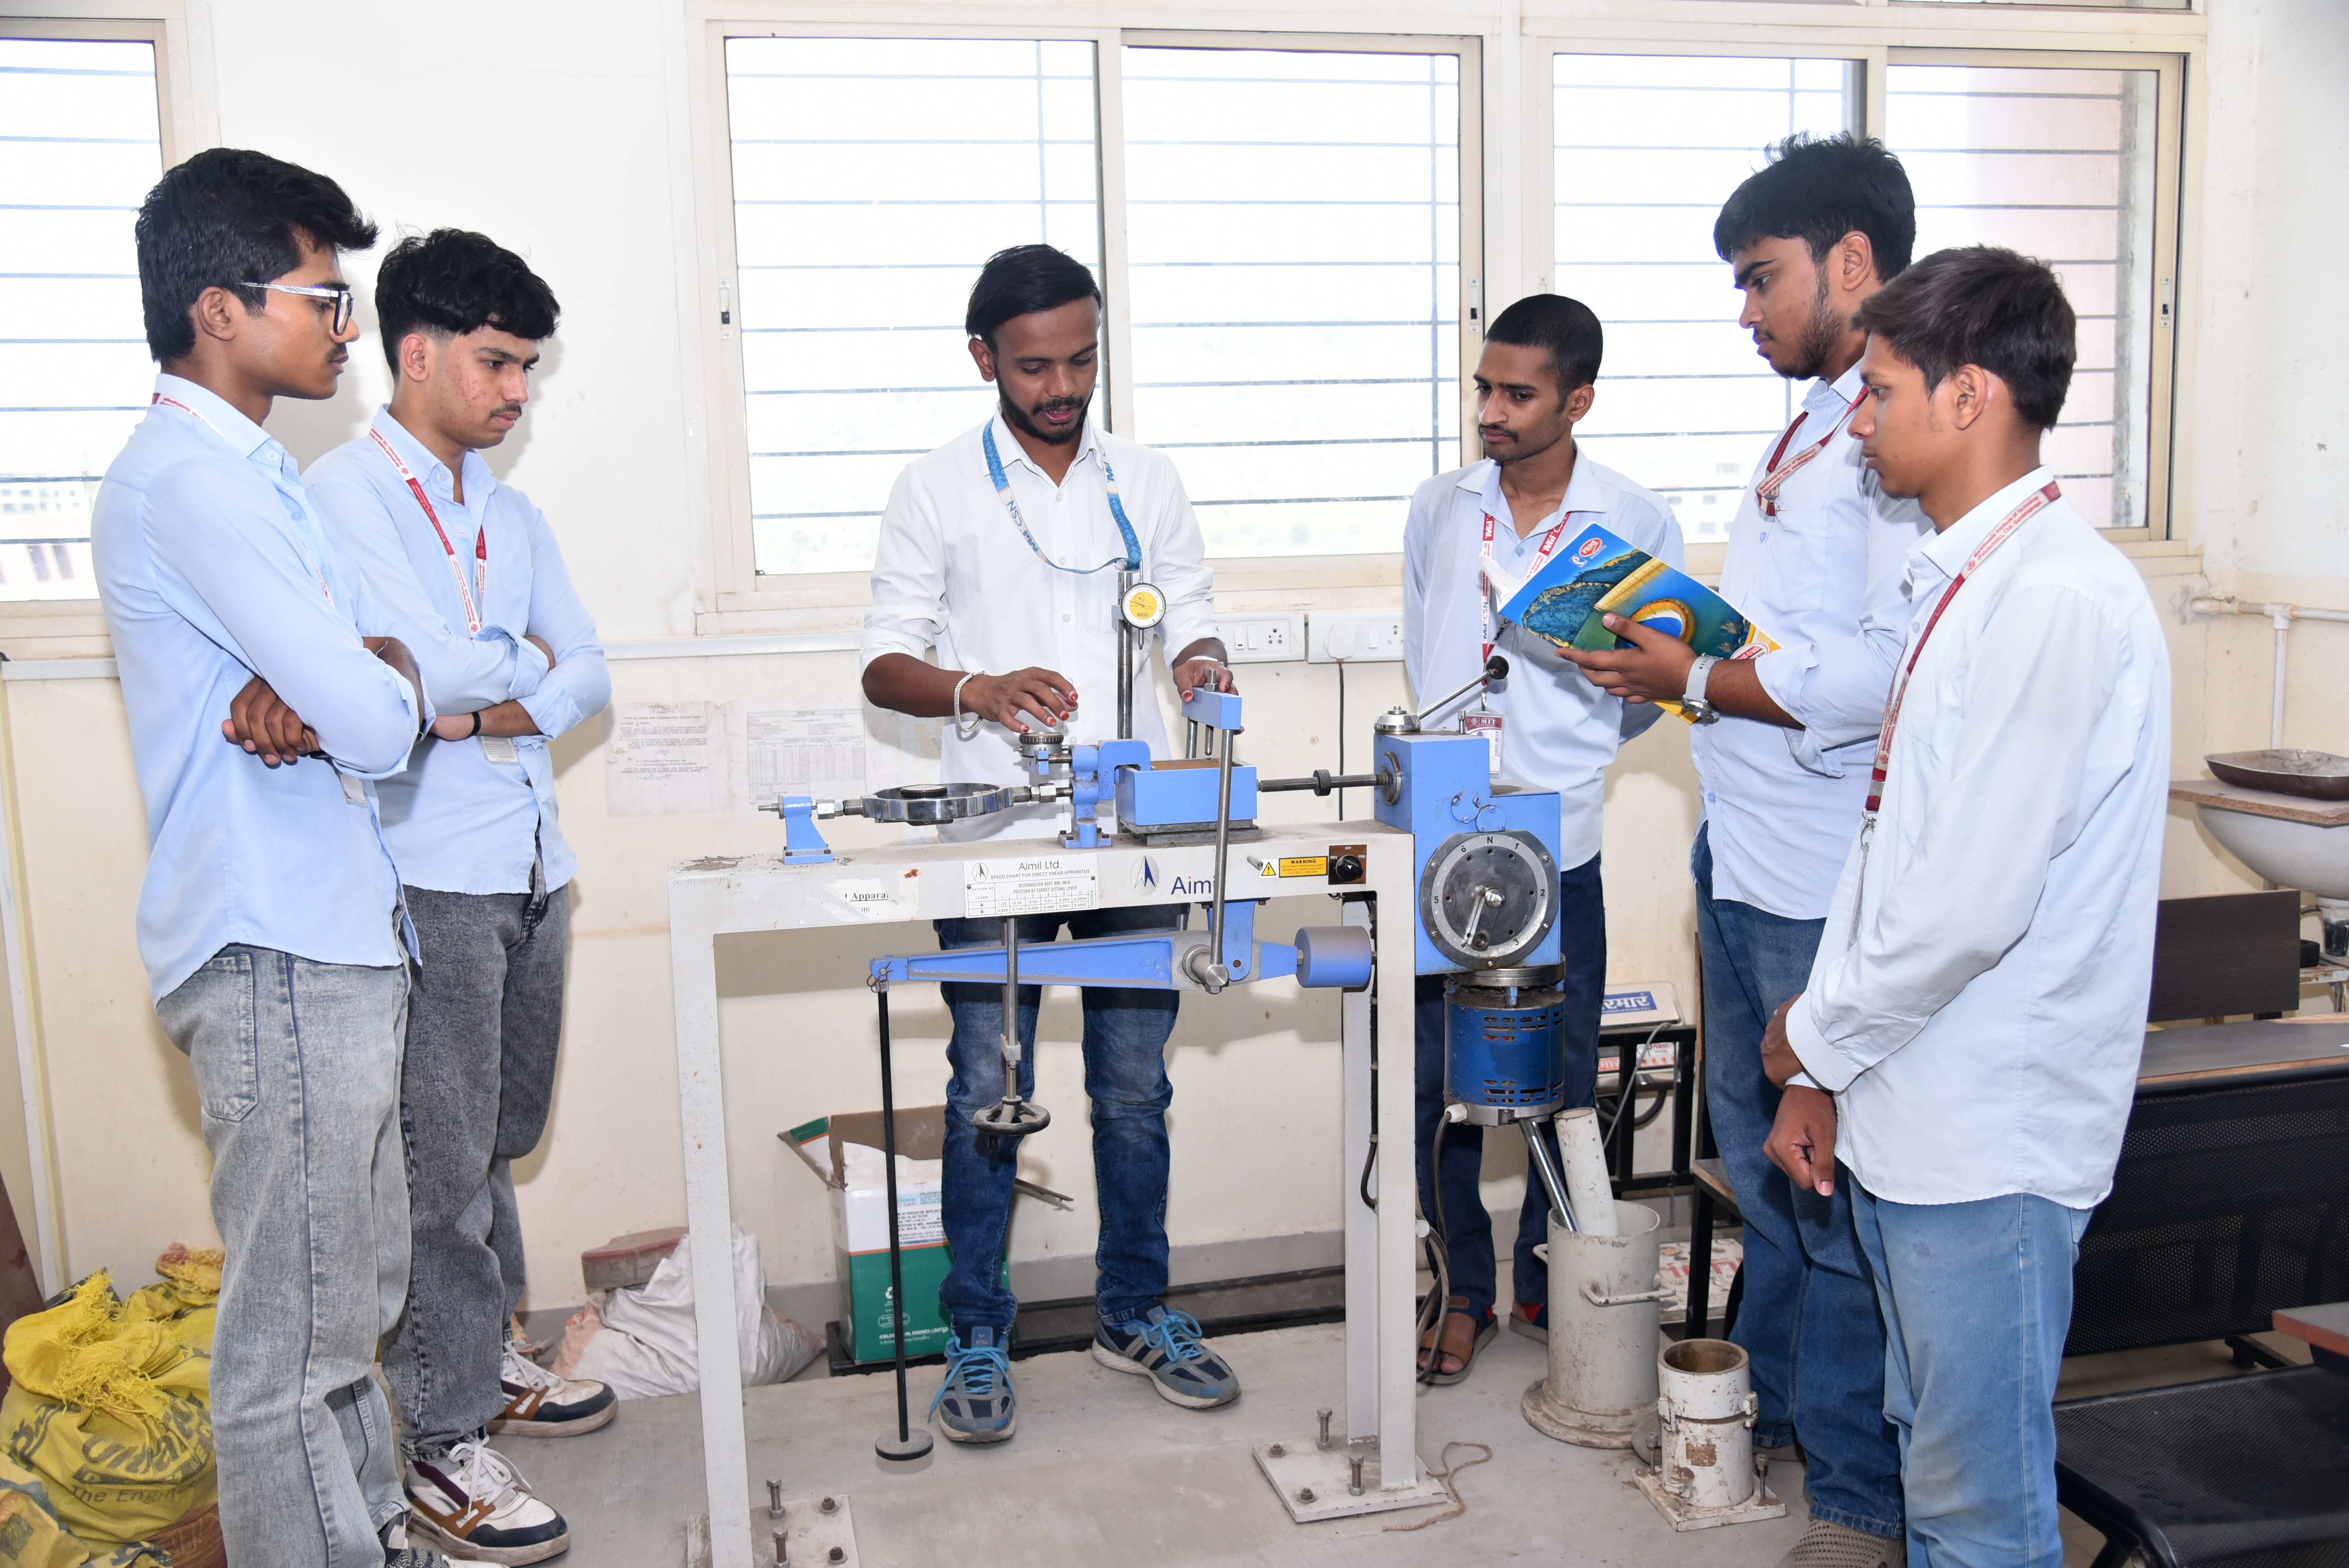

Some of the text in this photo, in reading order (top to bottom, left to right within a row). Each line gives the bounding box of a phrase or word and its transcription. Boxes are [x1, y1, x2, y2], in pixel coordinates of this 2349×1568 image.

[1007, 500, 1022, 526] CSN
[1974, 533, 1996, 558] Marathwada
[1995, 517, 2013, 533] Institute
[2017, 496, 2039, 513] Technology
[1581, 540, 1599, 554] PRIME
[1019, 860, 1062, 871] Aimil Ltd.
[72, 1484, 107, 1502] The
